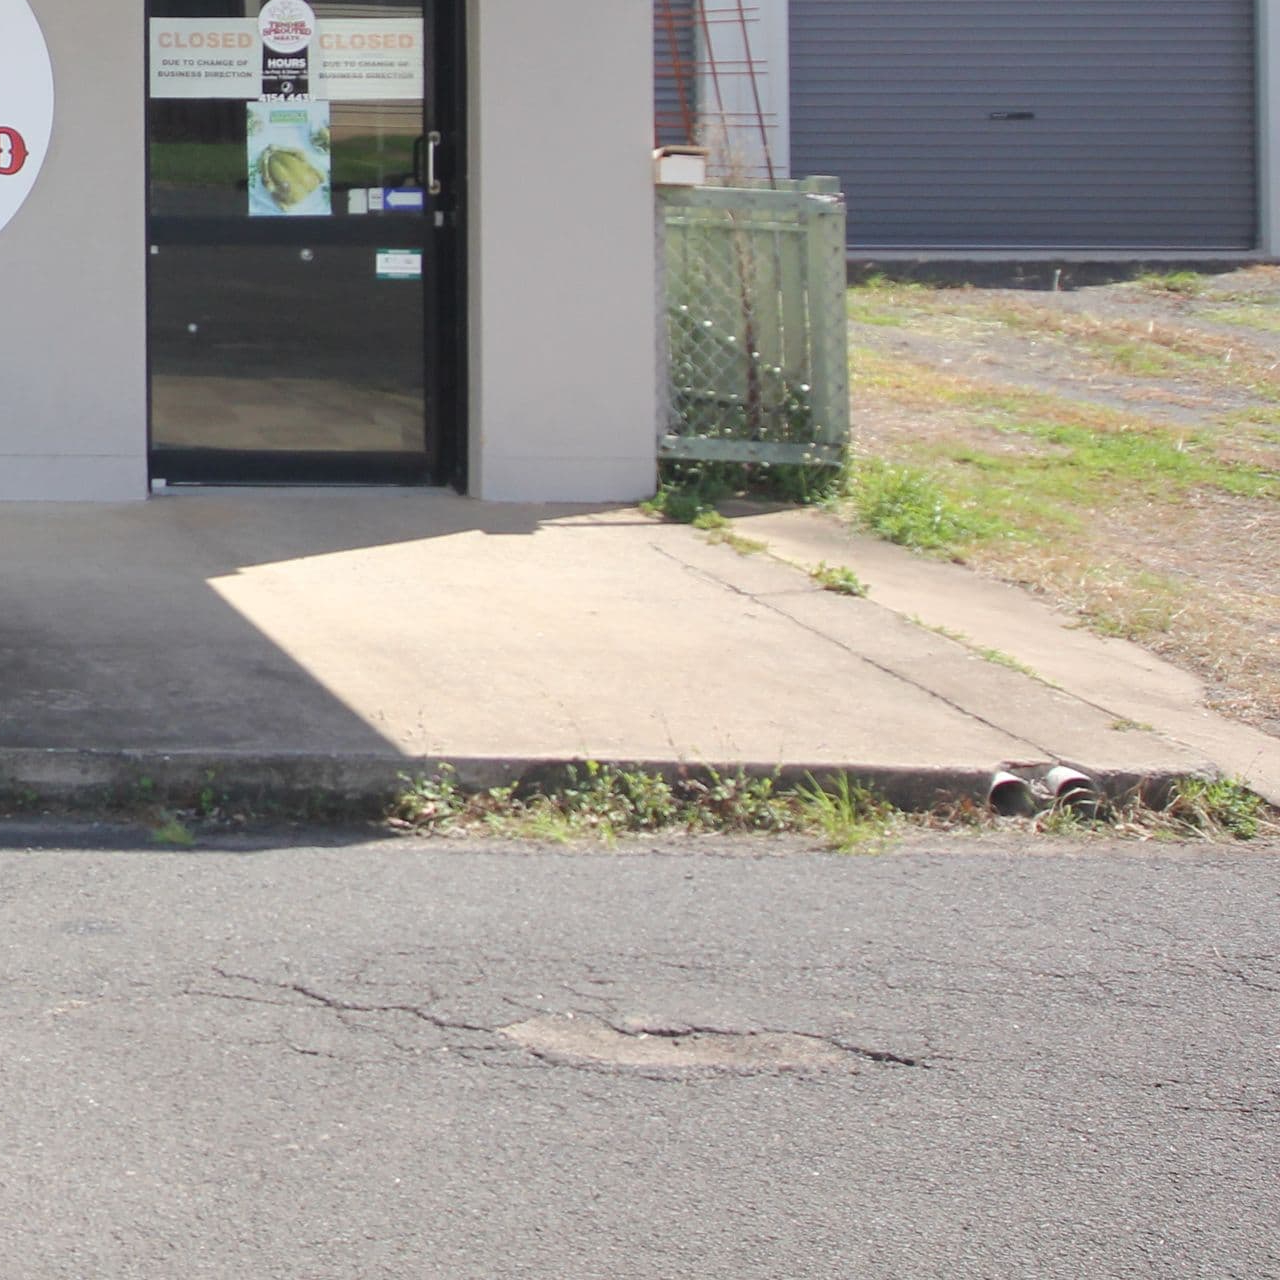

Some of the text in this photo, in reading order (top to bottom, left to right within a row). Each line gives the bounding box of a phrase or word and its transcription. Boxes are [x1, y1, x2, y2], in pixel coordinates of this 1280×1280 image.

[158, 31, 254, 49] CLOSED
[319, 33, 415, 49] CLOSED
[162, 58, 180, 66] DUE
[183, 58, 194, 66] TO
[197, 58, 234, 66] CHANGE
[267, 58, 307, 70] HOURS
[158, 70, 202, 78] BUSINESS
[204, 70, 253, 78] DIRECTION
